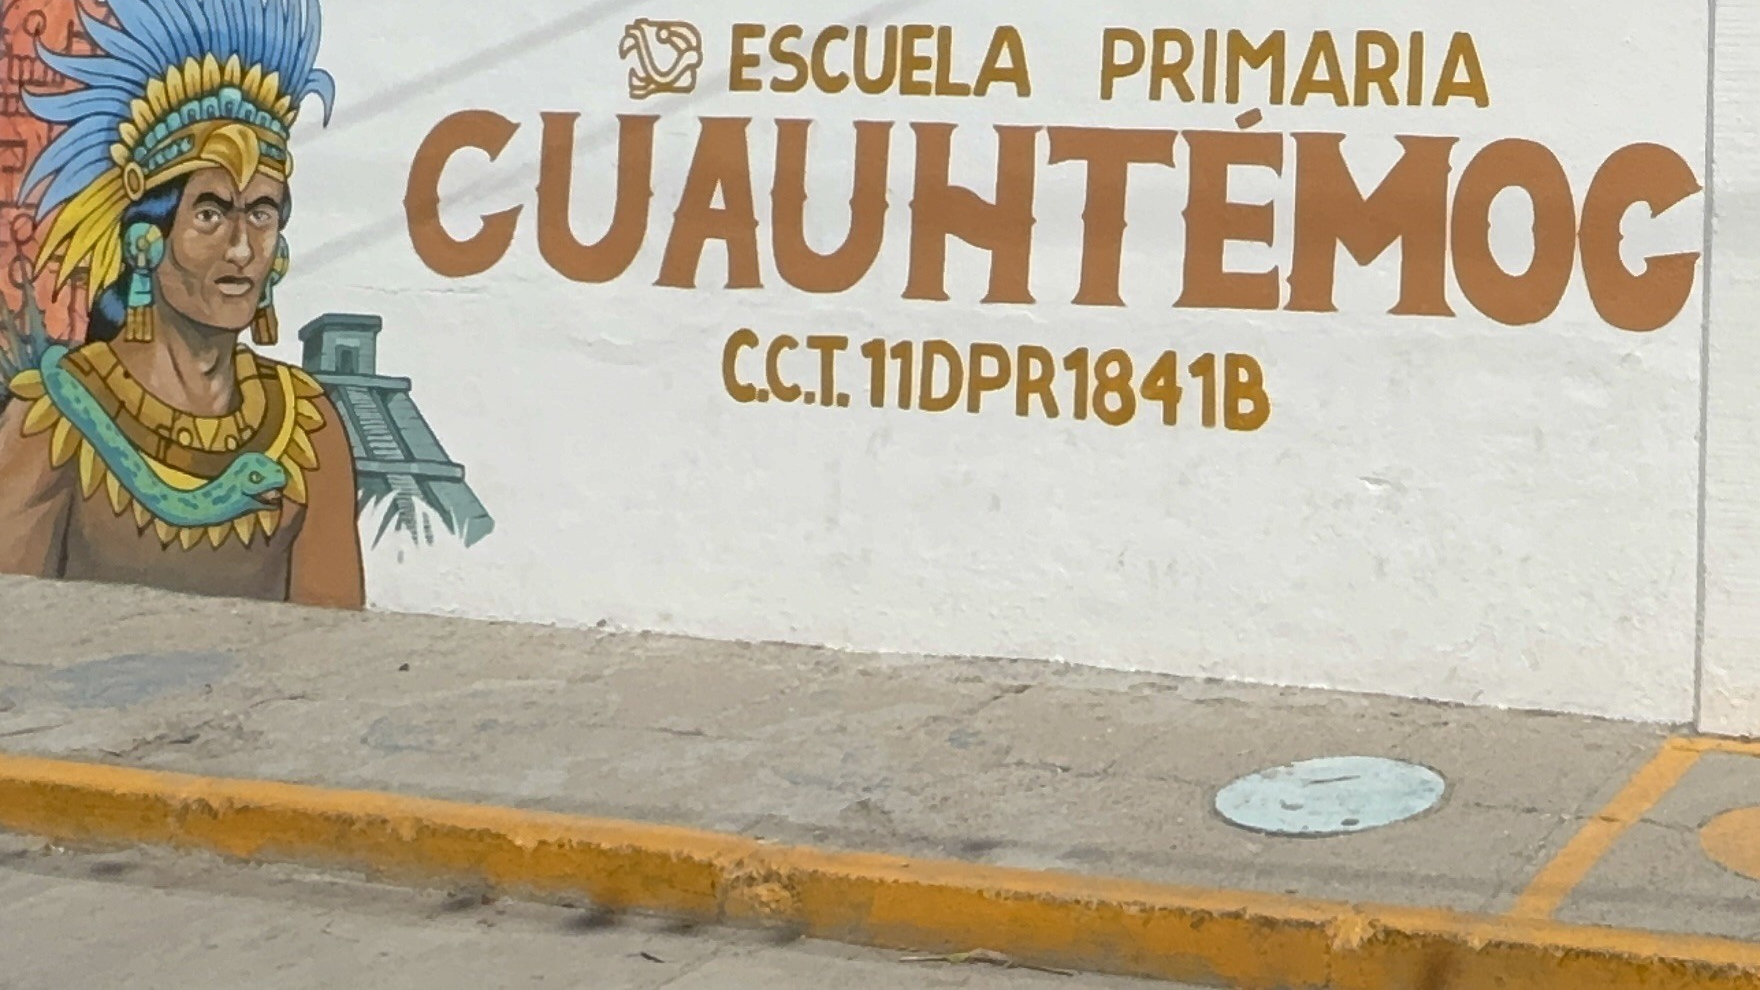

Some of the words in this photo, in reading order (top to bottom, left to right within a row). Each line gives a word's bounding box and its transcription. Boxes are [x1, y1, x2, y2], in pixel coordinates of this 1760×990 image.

[729, 23, 1032, 97] ESCUELA
[1099, 28, 1489, 108] PRIMARIA
[403, 108, 1703, 332] CUAUHTÉMOC
[861, 339, 1271, 431] 11DPR1841B
